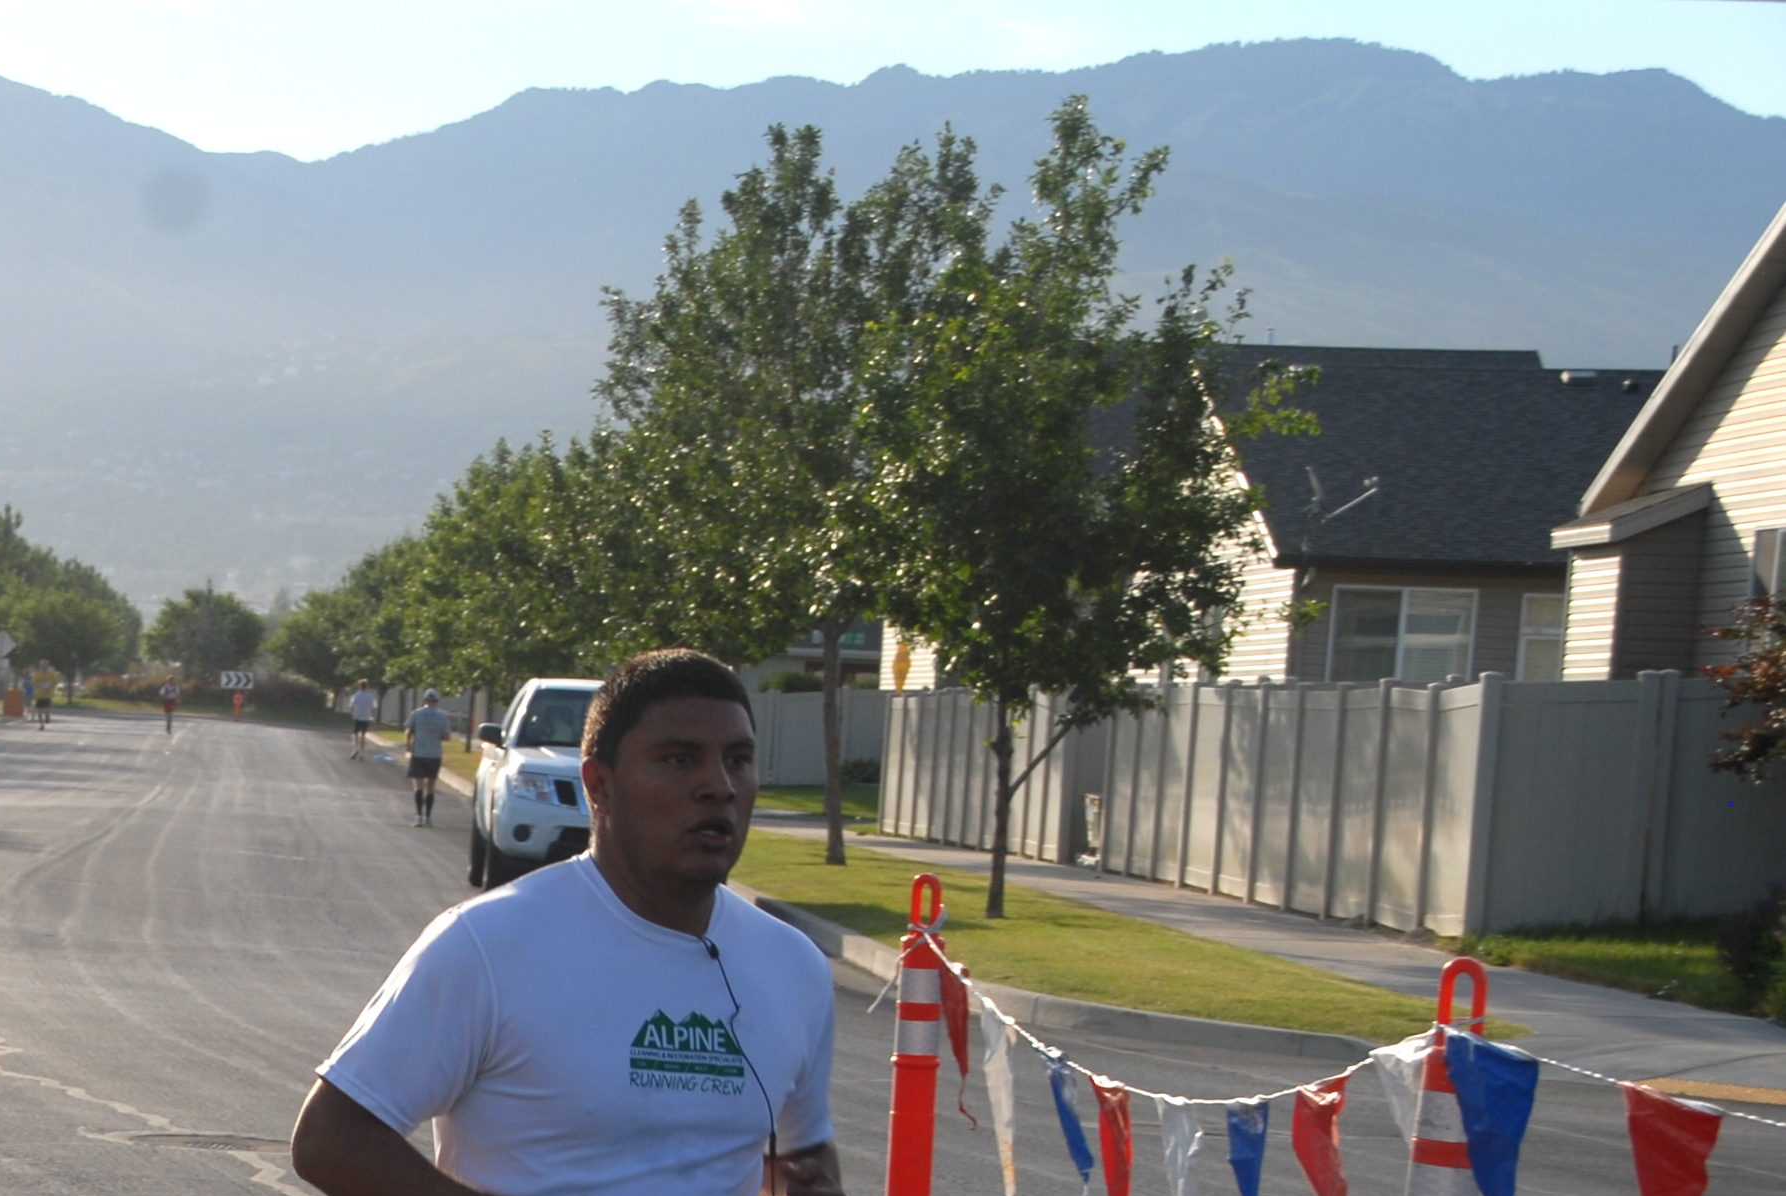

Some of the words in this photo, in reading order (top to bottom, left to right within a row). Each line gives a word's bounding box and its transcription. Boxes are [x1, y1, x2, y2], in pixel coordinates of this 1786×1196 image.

[643, 1023, 727, 1053] ALPINE
[629, 1071, 698, 1092] RUNNING
[700, 1077, 745, 1096] CREW
